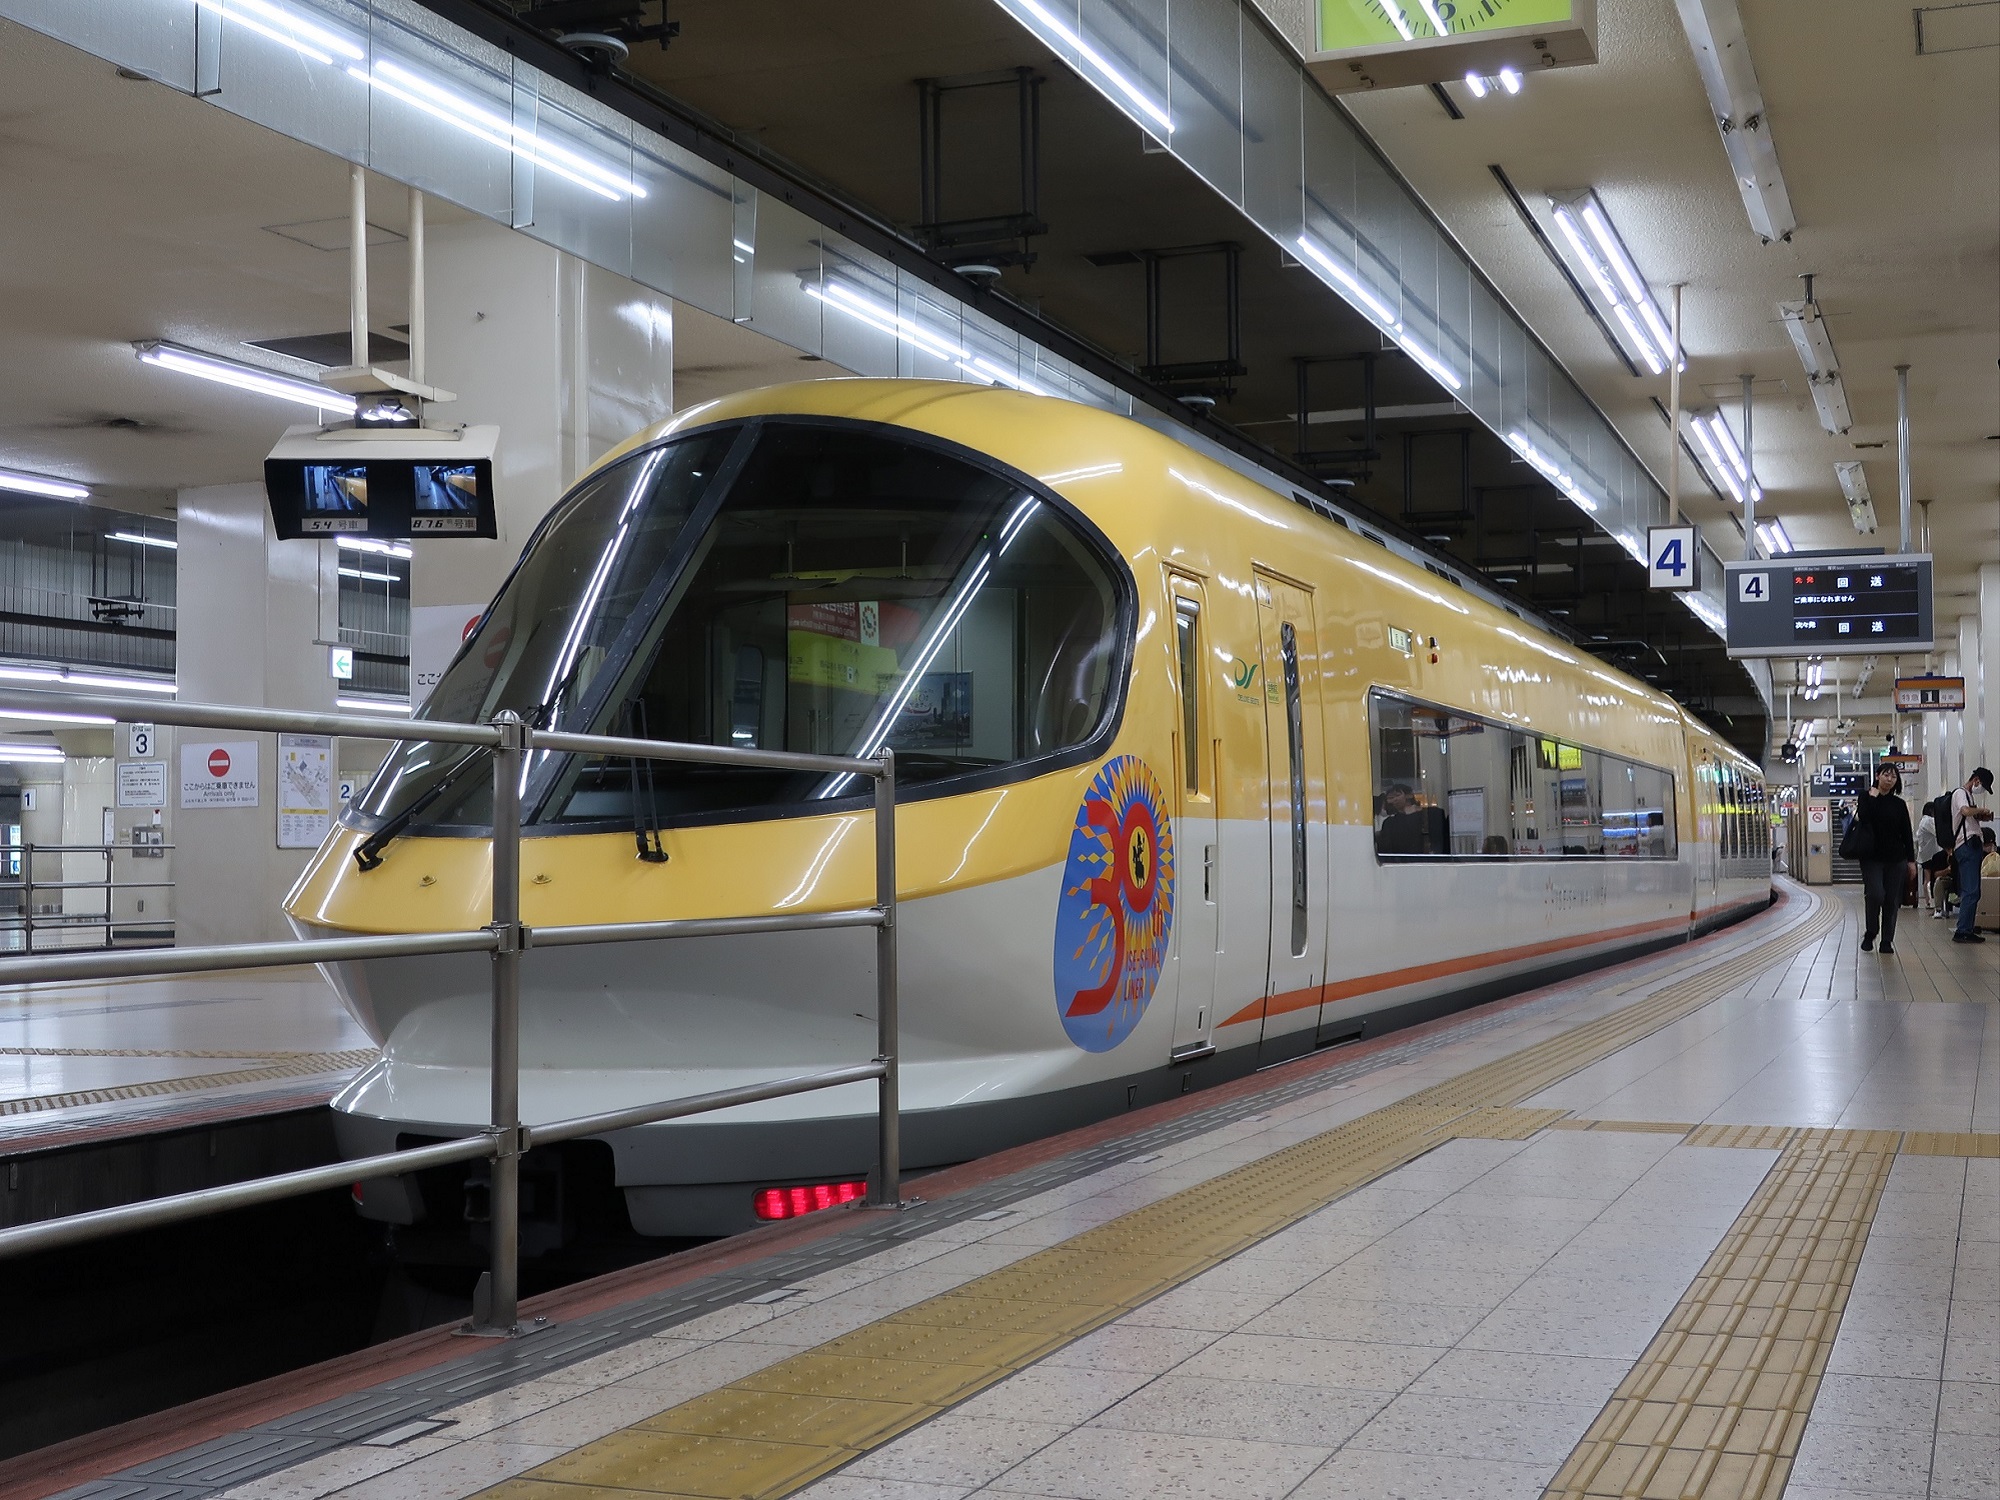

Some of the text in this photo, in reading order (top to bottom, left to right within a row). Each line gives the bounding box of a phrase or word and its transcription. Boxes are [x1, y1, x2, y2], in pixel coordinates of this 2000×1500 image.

[1655, 539, 1687, 577] 4
[1744, 576, 1763, 598] 4
[1925, 690, 1936, 703] 1
[135, 733, 148, 754] 3
[1823, 767, 1833, 779] 4
[24, 792, 30, 806] 1
[223, 789, 236, 798] only
[340, 784, 350, 799] 2
[1065, 800, 1158, 1018] 30
[1152, 898, 1163, 937] th
[1126, 948, 1161, 972] ISE-SHIMA
[1123, 977, 1145, 1001] LINER
